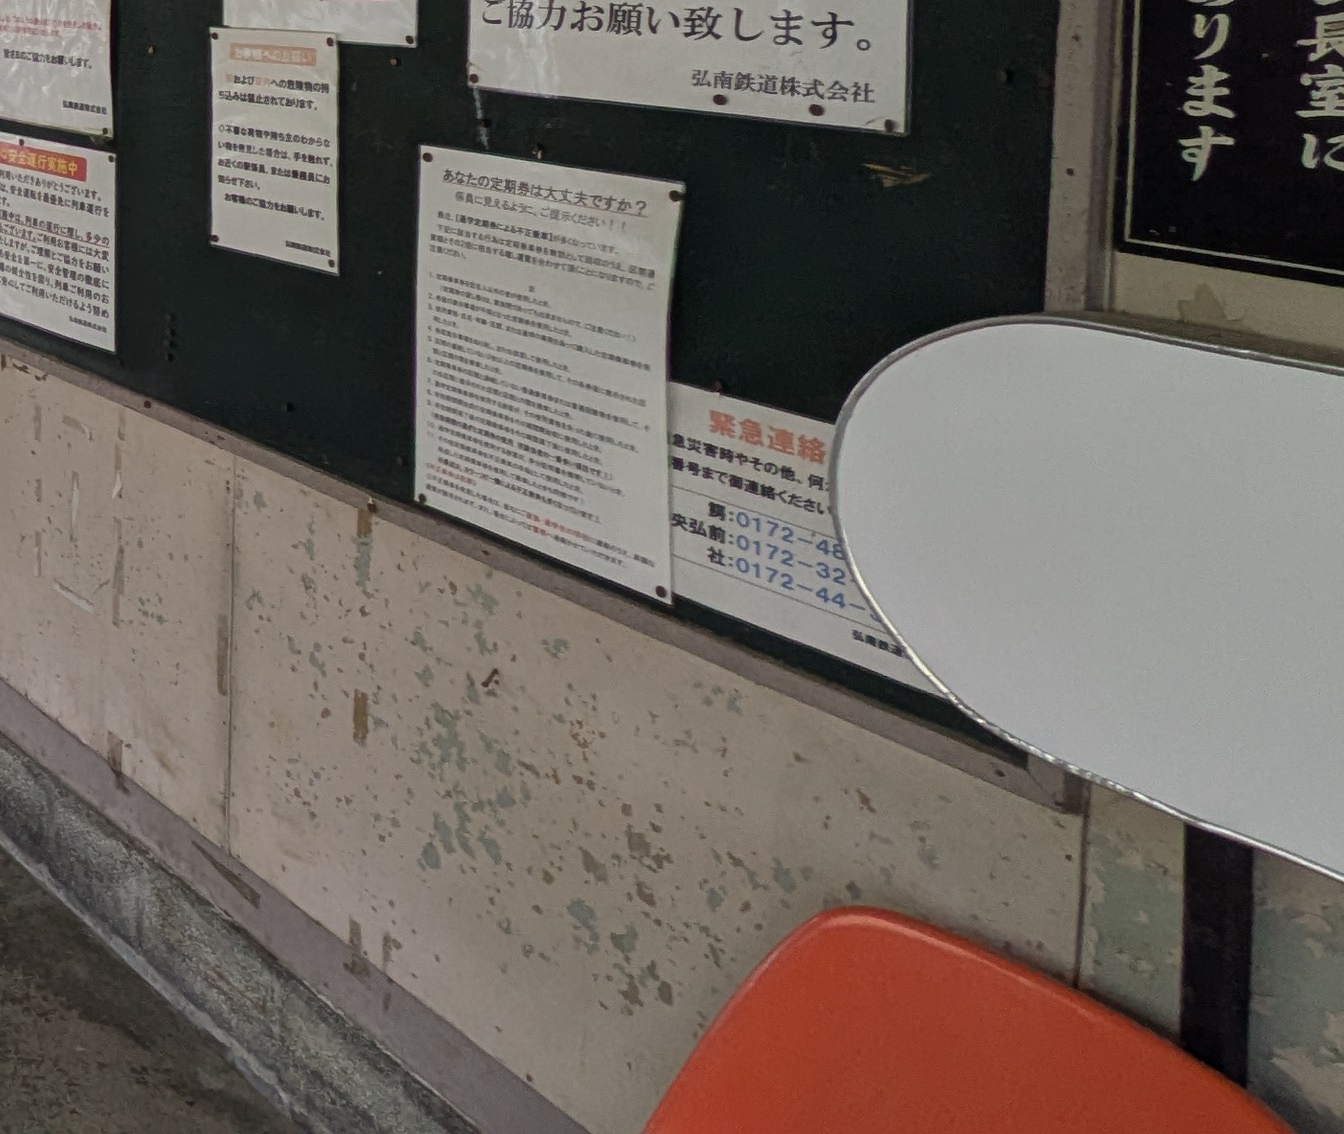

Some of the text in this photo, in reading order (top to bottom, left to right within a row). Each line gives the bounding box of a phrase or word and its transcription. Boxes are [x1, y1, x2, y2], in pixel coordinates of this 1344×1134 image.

[691, 68, 876, 104] 弘南鉄道株式会社
